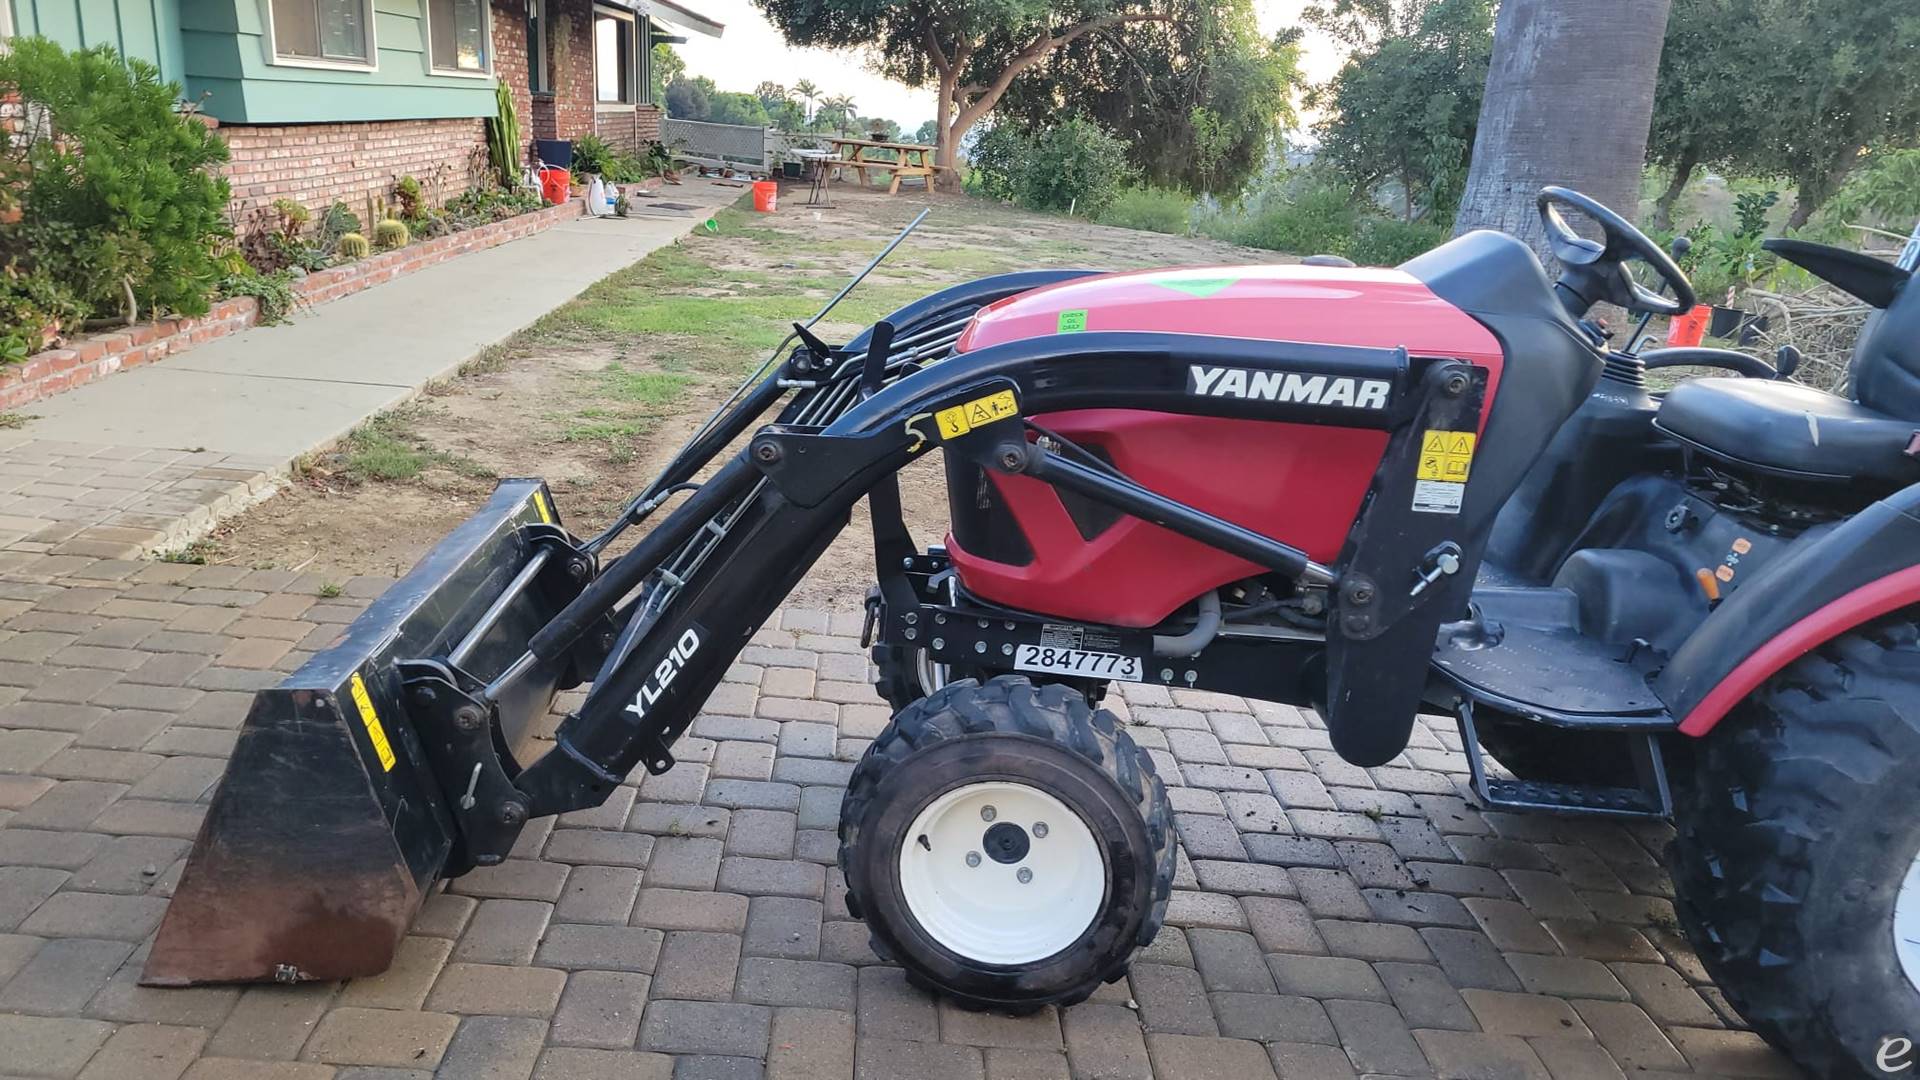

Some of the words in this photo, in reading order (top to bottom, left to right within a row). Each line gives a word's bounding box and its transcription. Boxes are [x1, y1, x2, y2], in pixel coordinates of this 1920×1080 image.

[1190, 365, 1391, 409] YANMAR
[625, 628, 700, 719] YL210
[1024, 646, 1136, 675] 2847773
